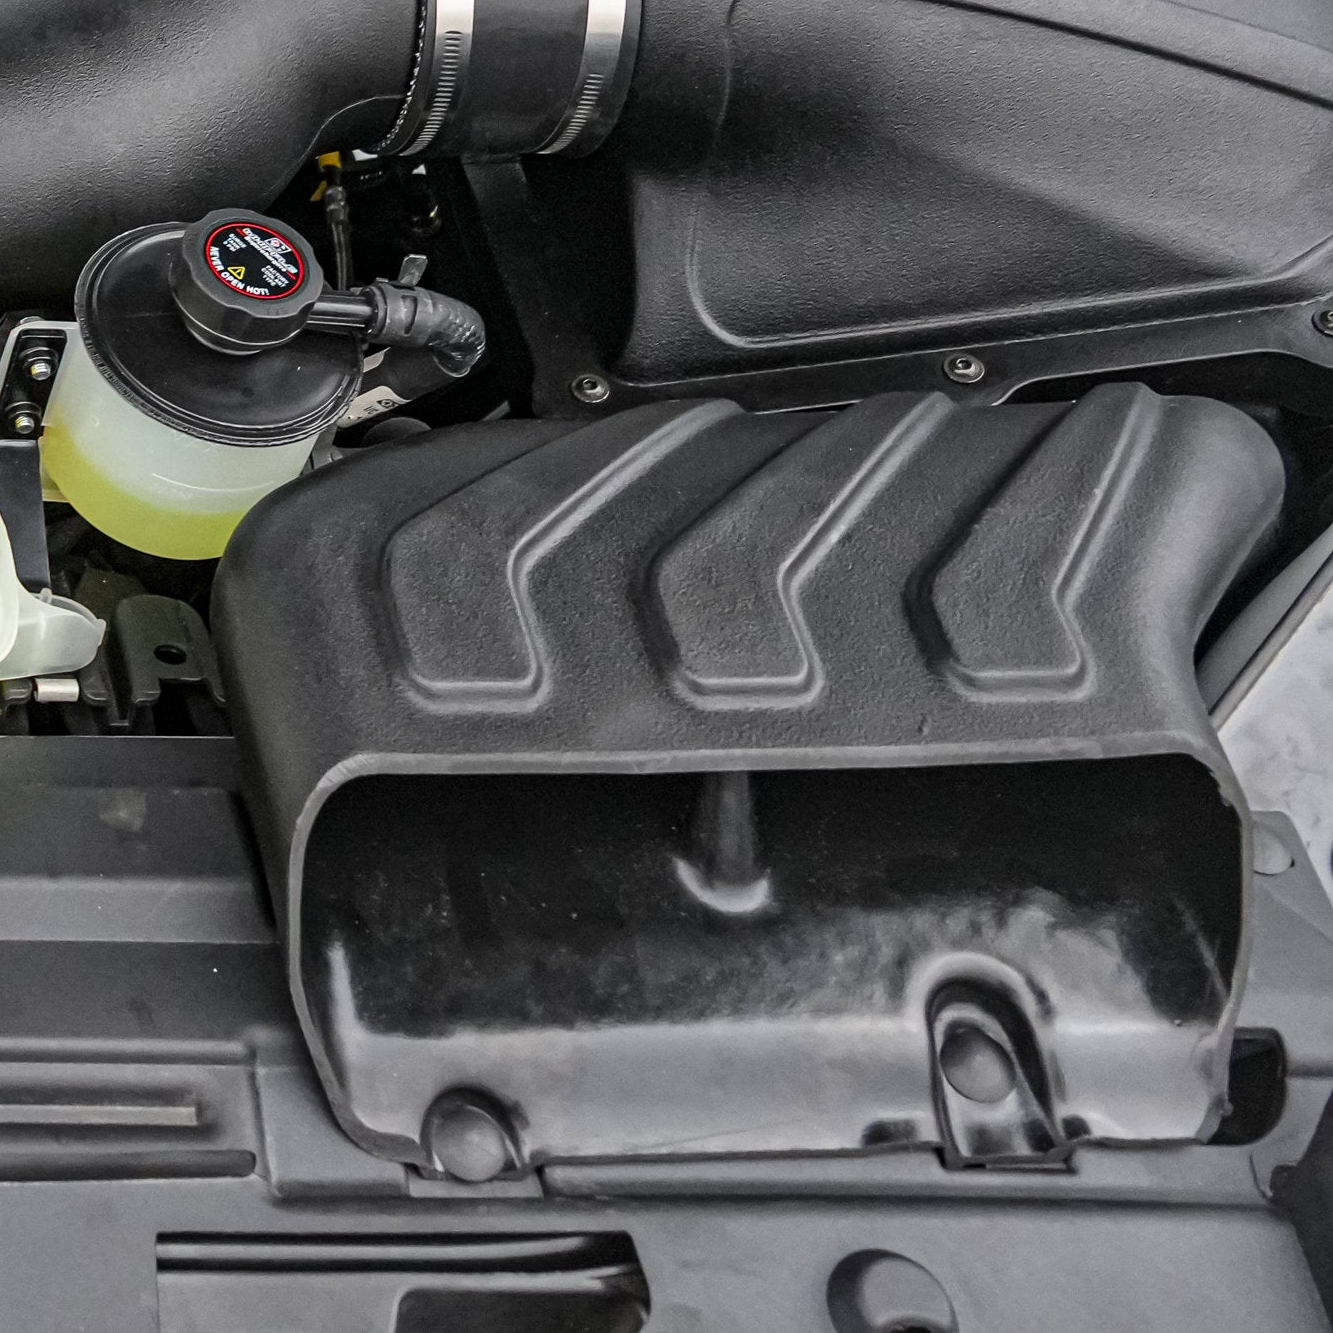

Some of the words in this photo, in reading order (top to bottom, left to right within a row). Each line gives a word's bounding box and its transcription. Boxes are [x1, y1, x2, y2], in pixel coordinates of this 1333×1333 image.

[210, 246, 225, 272] NEVER
[220, 272, 244, 290] OPEN
[246, 285, 270, 295] HOT!
[265, 265, 289, 284] FACTORY
